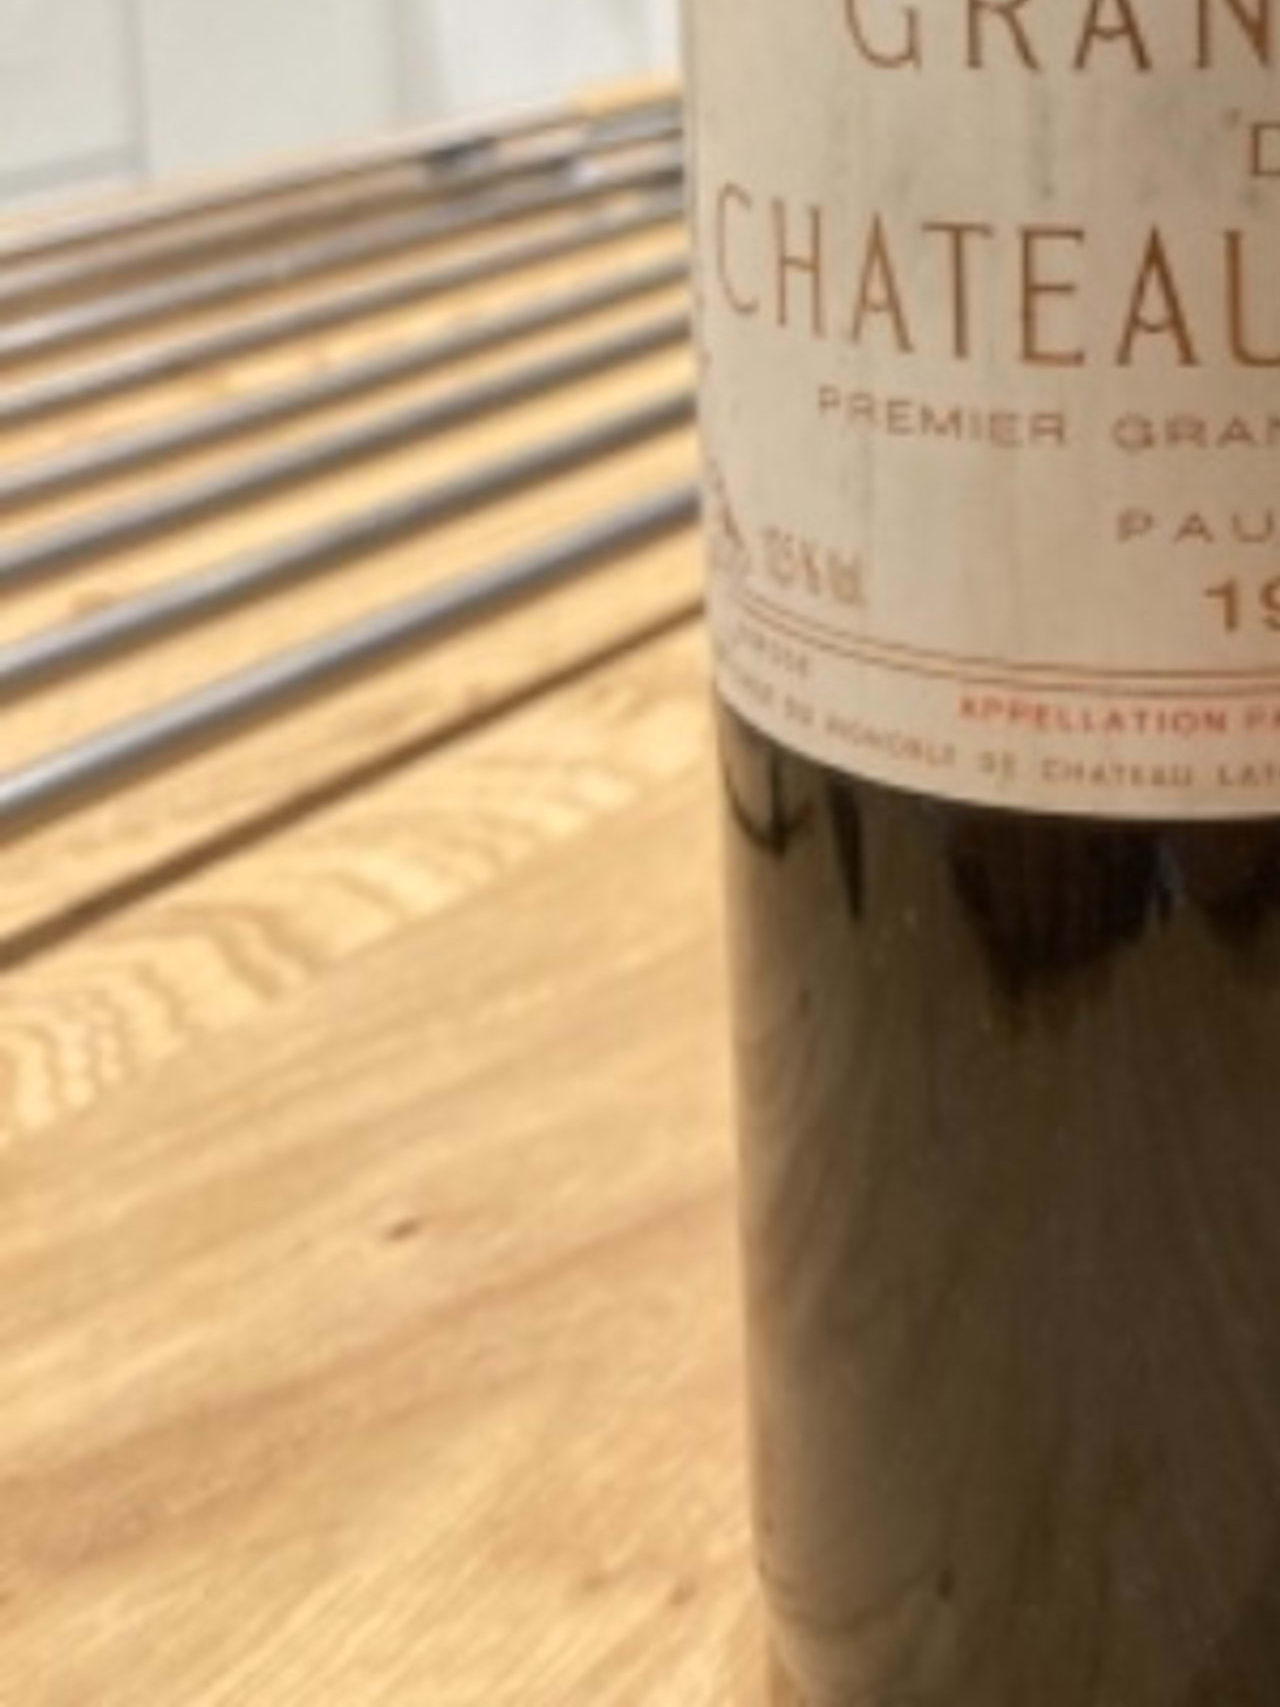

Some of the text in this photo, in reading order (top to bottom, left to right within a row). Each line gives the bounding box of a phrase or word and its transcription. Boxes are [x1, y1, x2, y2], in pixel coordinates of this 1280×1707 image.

[819, 384, 1068, 448] PREMIER
[958, 695, 1228, 735] APPELLATION
[1040, 755, 1195, 788] CHATEAU
